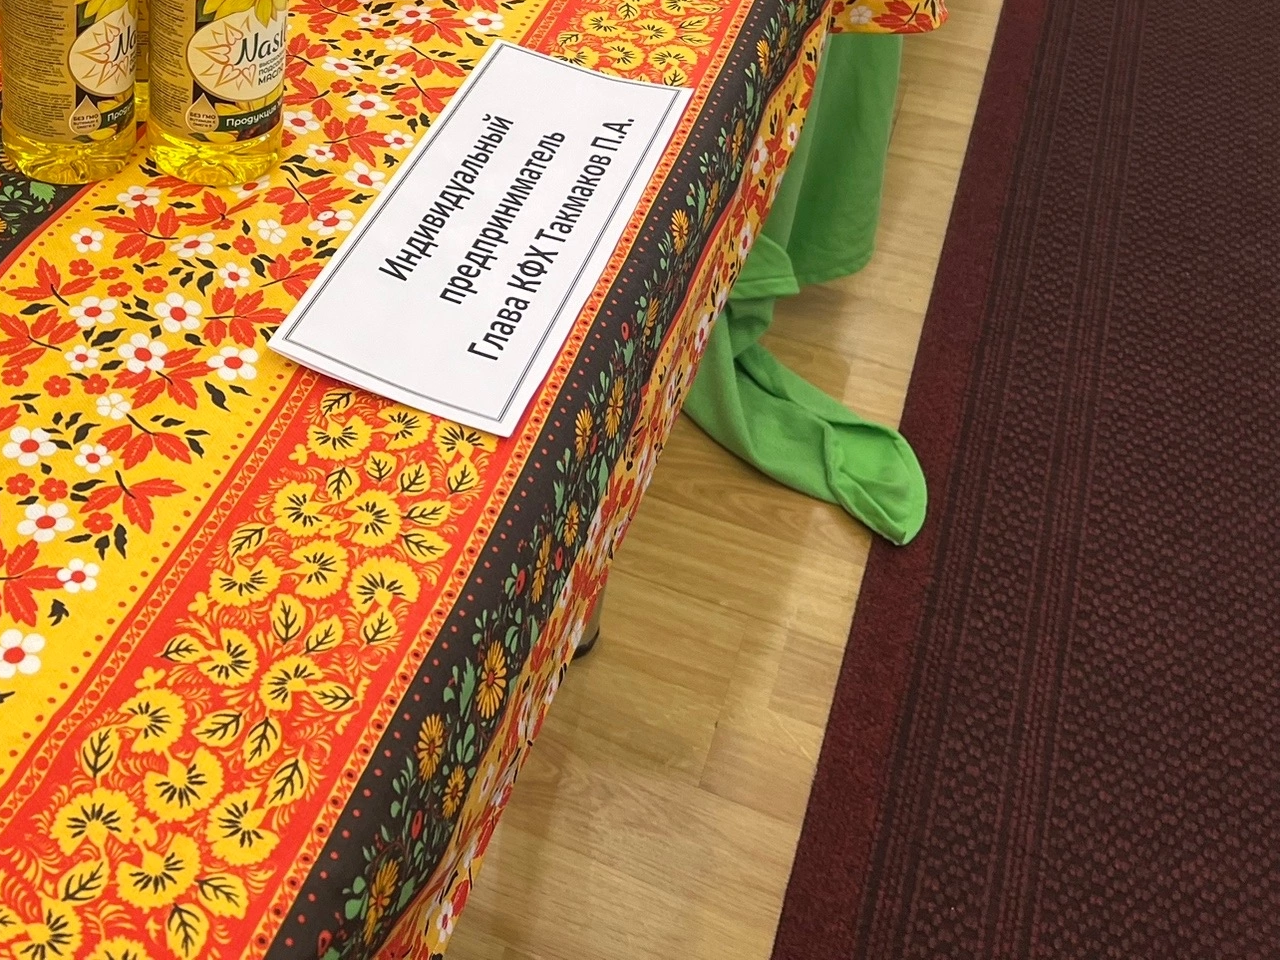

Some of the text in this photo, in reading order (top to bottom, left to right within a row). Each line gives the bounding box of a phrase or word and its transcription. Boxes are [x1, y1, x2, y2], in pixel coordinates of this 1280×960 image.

[378, 113, 514, 282] Индивидуальный
[439, 132, 566, 305] предприниматель
[467, 117, 635, 361] Глава КФХ Такмаков П.А.
